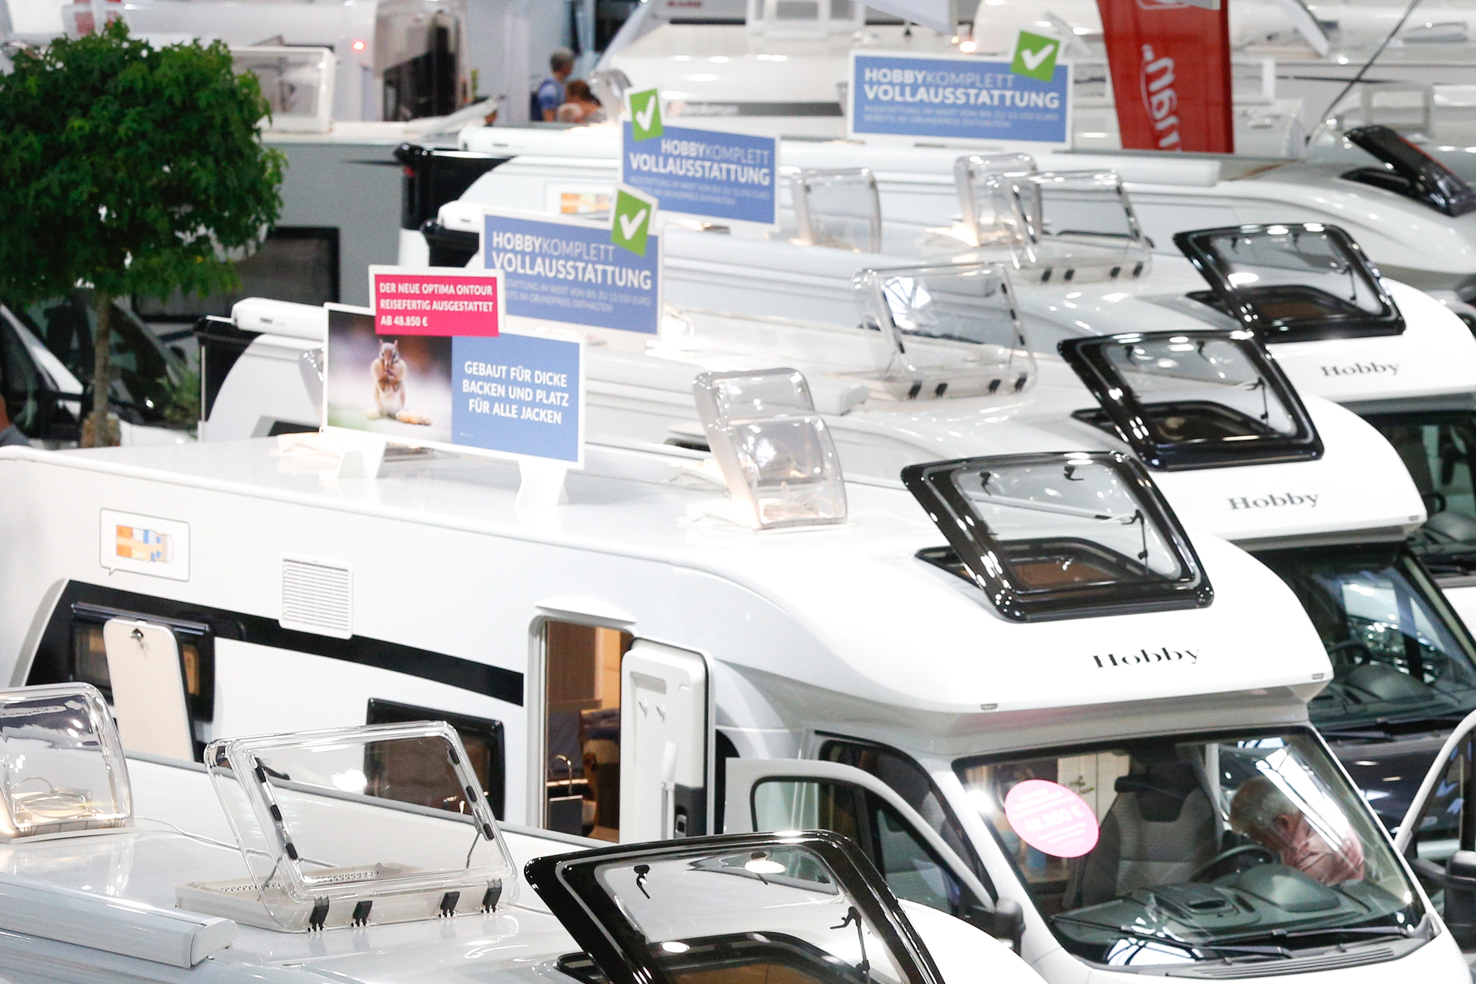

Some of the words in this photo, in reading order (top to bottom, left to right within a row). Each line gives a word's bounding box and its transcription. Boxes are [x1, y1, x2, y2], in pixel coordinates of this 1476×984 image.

[864, 68, 1015, 89] HOBBYKOMPLETT
[864, 84, 1060, 109] VOLLAUSSTATTUNG
[661, 138, 770, 166] HOBBYKOMPLETT
[629, 152, 771, 186] VOLLAUSSTATTUNG
[493, 231, 615, 263] HOBBYKOMPLETT
[493, 252, 652, 290] VOLLAUSSTATTUNG
[379, 282, 397, 294] DER
[398, 283, 420, 294] NEUE
[421, 284, 455, 296] OPTIMA
[456, 285, 493, 296] ONTOUR
[380, 299, 431, 311] REISEFERTIG
[432, 300, 494, 312] AUSGESTATTET
[380, 316, 393, 326] AB
[394, 316, 422, 327] 48.850
[422, 317, 428, 327] €
[464, 360, 508, 379] GEBAUT
[510, 365, 531, 383] FÜR
[534, 369, 567, 387] DICKE
[1320, 361, 1400, 376] Hobby
[462, 379, 506, 398] BACKEN
[508, 385, 533, 401] UND
[535, 389, 569, 407] PLATZ
[468, 397, 490, 415] FÜR
[492, 401, 518, 418] ALLE
[520, 405, 562, 424] JACKEN
[1227, 492, 1319, 510] Hobby
[1092, 647, 1200, 668] Hobby
